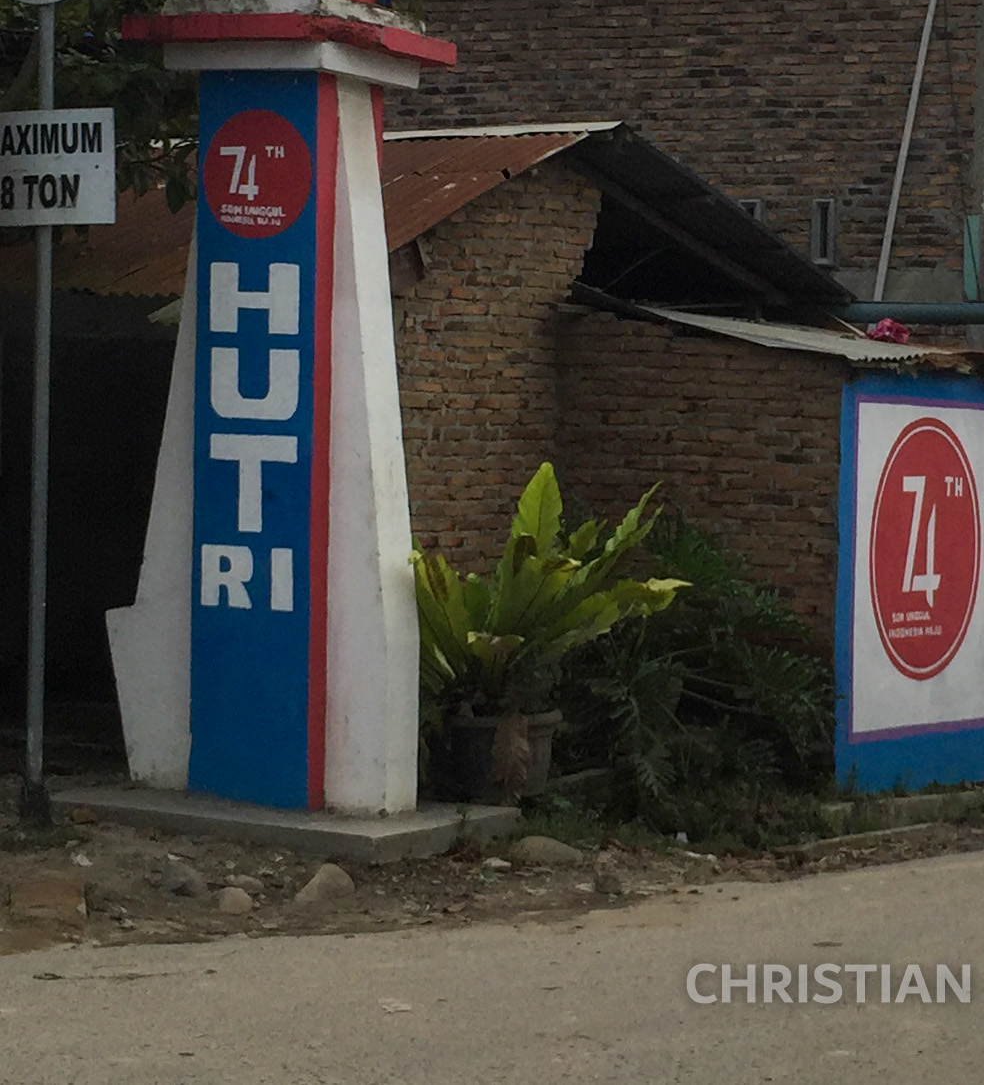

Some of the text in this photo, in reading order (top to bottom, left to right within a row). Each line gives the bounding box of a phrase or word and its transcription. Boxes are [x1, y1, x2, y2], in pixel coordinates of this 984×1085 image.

[1, 122, 102, 155] AXIMUM
[23, 174, 80, 209] TON
[200, 544, 294, 612] RI
